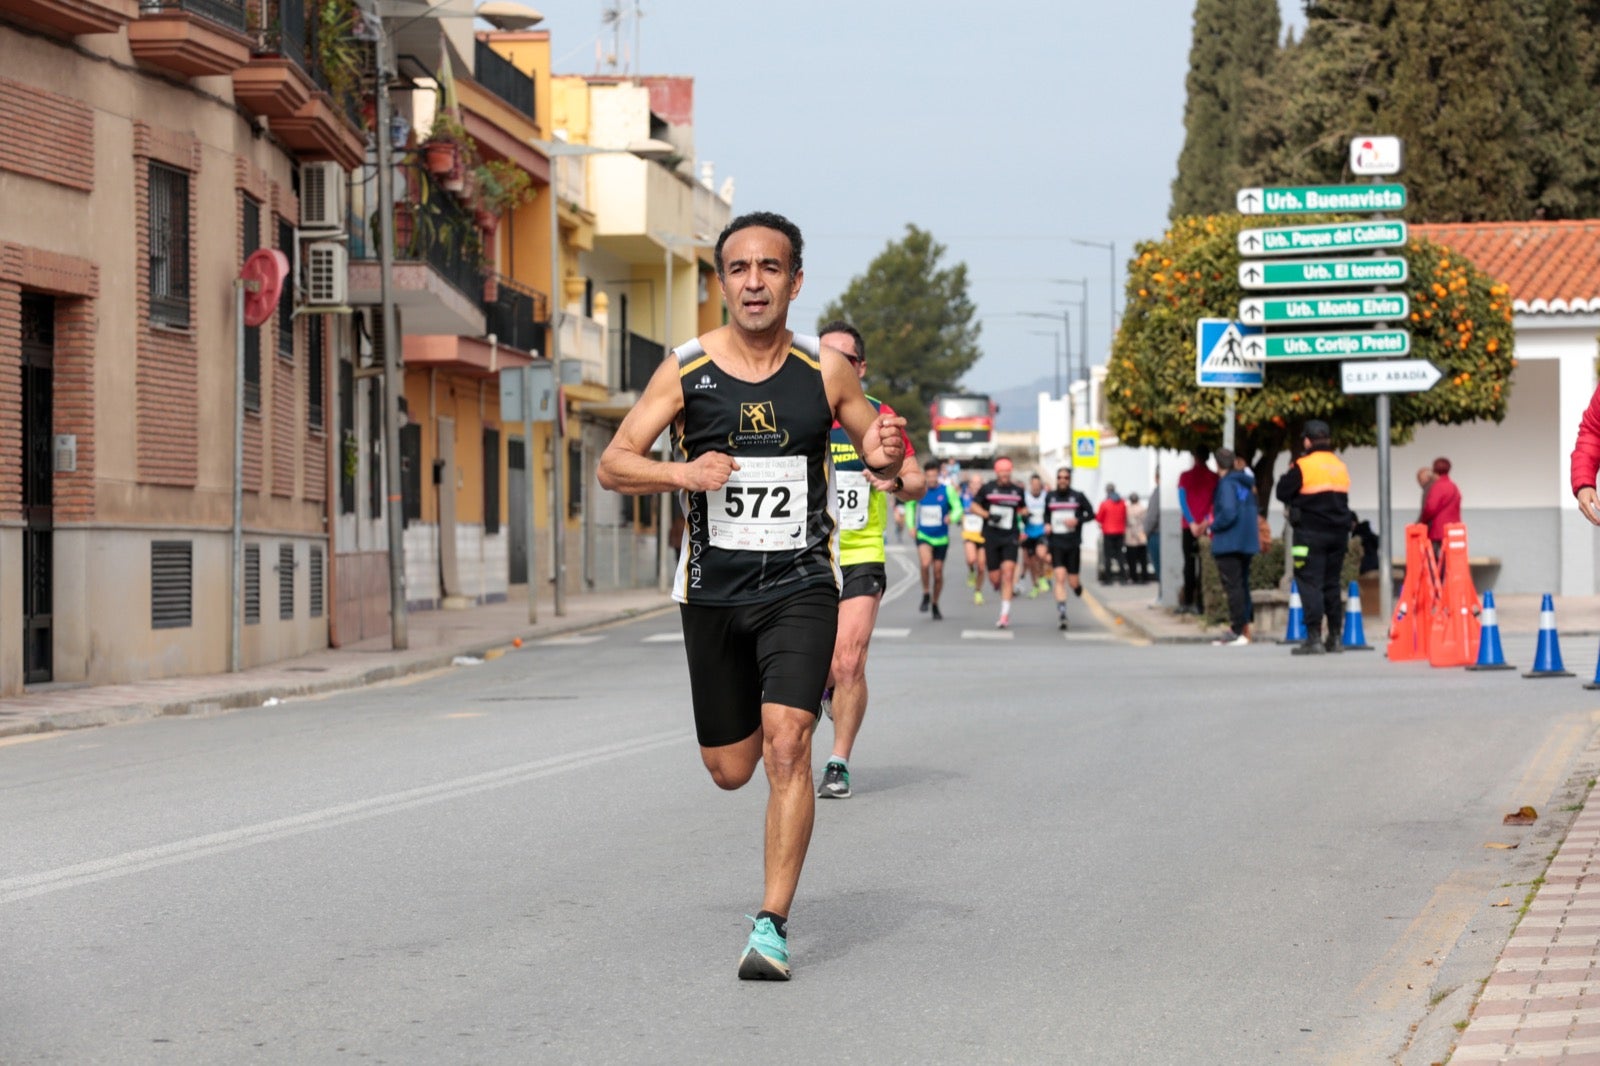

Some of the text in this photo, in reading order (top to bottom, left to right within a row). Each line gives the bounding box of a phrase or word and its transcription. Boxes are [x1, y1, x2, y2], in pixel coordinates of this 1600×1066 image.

[1266, 190, 1402, 210] Urb. Buenavista
[1265, 232, 1290, 248] Urb.
[1333, 229, 1352, 243] del
[1303, 264, 1332, 280] Urb.
[1335, 263, 1349, 278] El
[1286, 299, 1400, 317] Urb. Monte Elvira
[1283, 338, 1312, 353] Urb.
[1315, 337, 1360, 355] Cortijo
[735, 433, 781, 442] GRANADA JOVEN
[725, 486, 791, 519] 572
[690, 536, 702, 589] JOVEN
